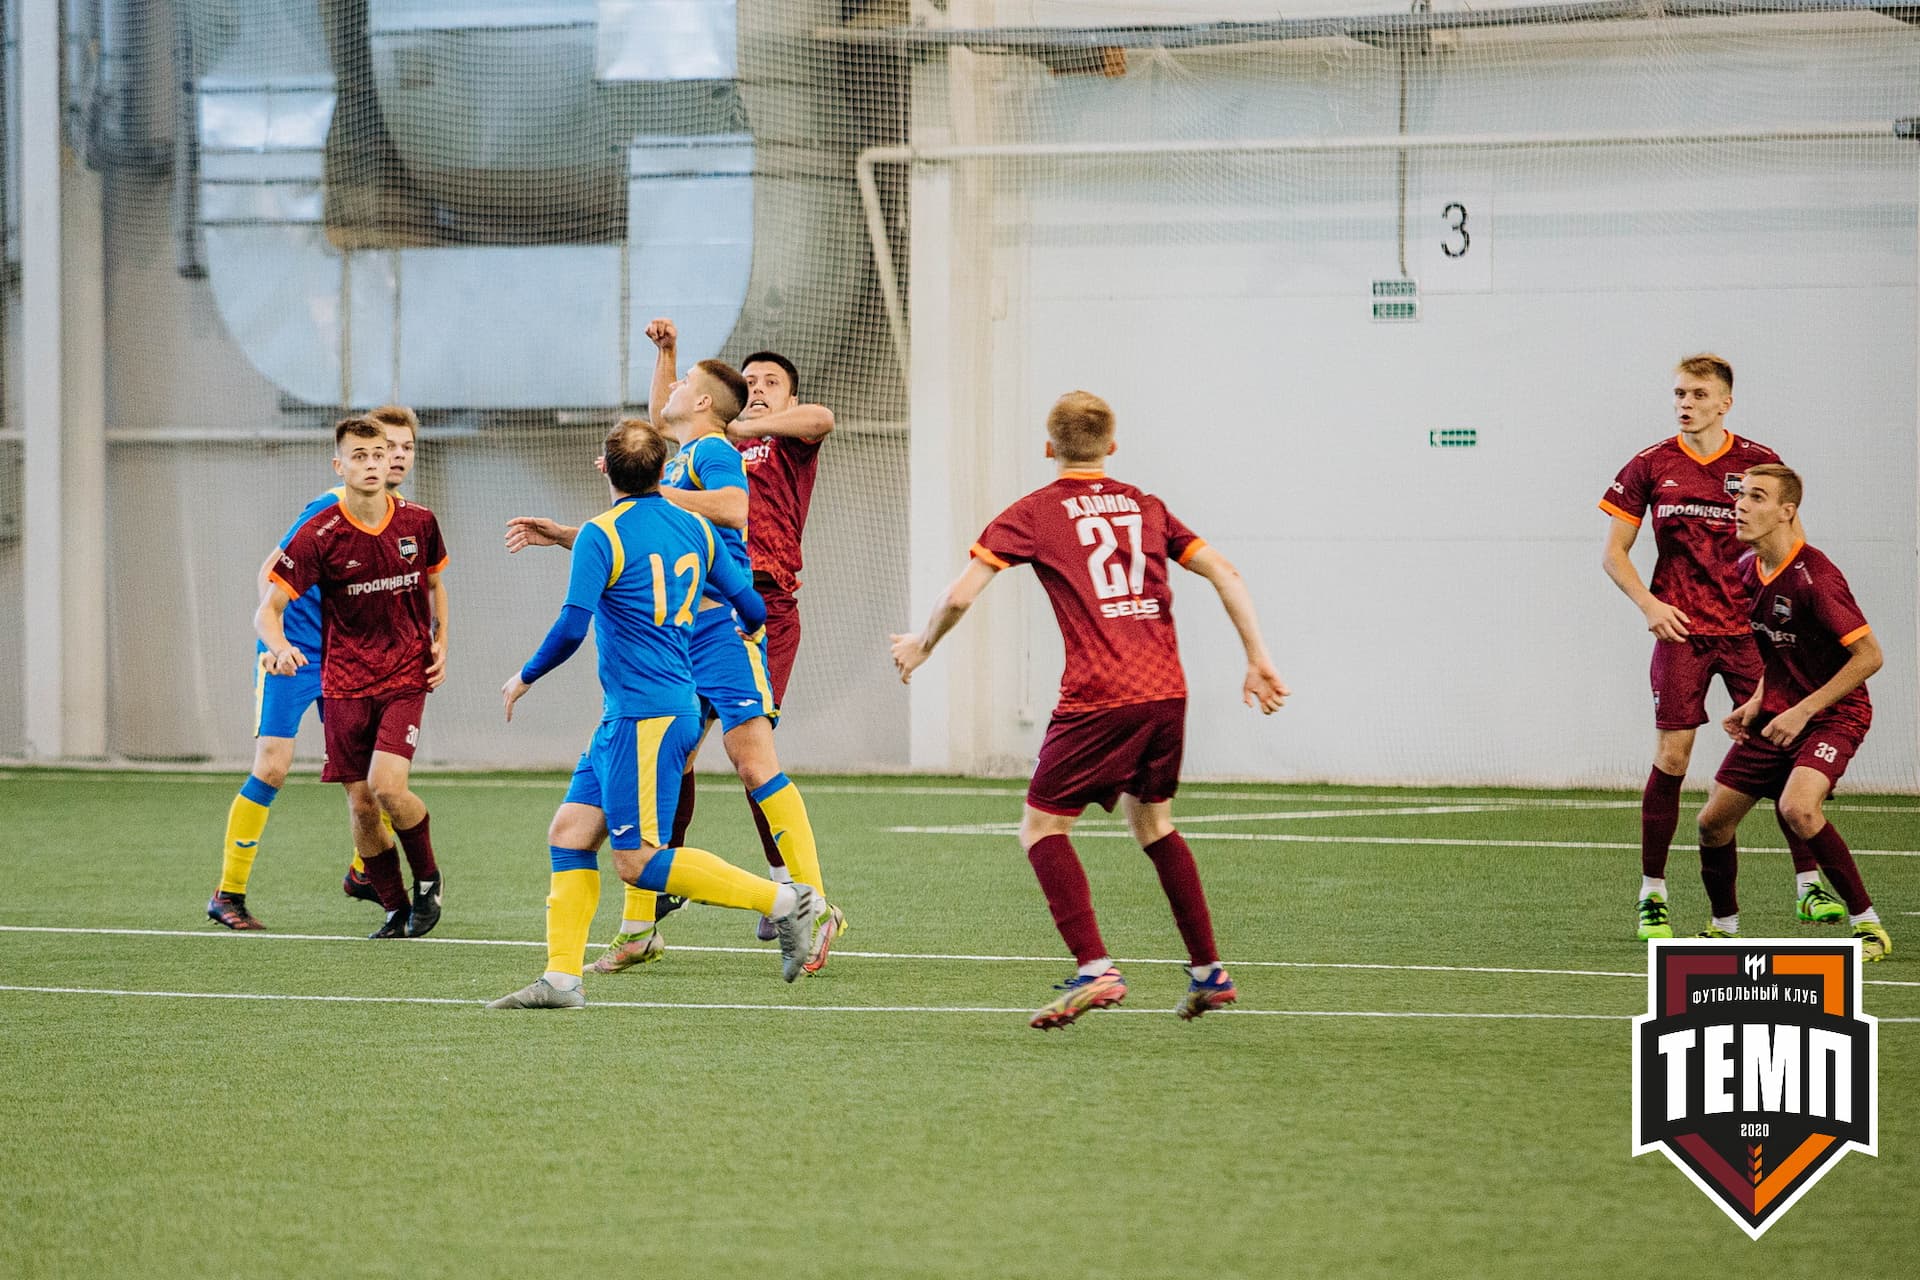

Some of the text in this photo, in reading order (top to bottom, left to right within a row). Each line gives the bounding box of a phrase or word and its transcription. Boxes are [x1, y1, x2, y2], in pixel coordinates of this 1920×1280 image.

[1441, 202, 1470, 257] 3
[1061, 494, 1141, 519] ЖДАНОВ
[1657, 503, 1736, 519] ПРОДИНВЕС
[1076, 514, 1146, 599] 27
[649, 552, 701, 627] 12
[1100, 598, 1160, 618] SELS
[1813, 741, 1838, 763] 33
